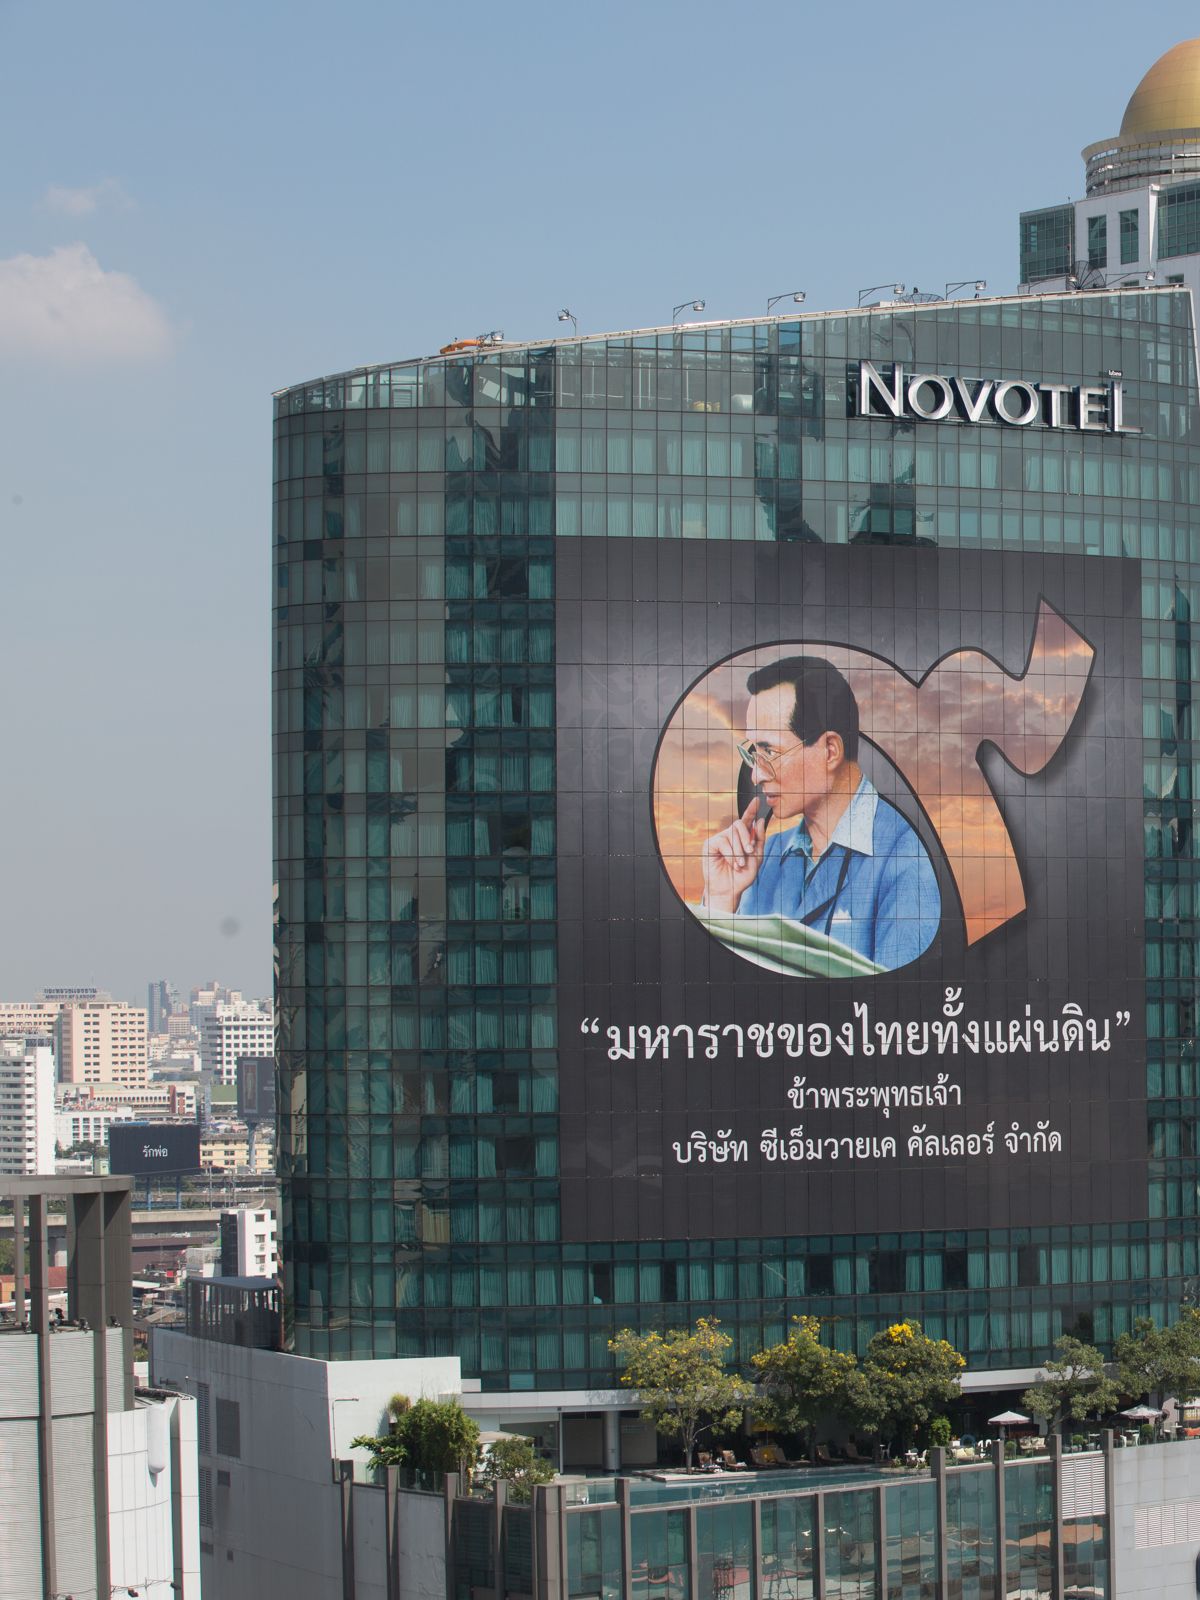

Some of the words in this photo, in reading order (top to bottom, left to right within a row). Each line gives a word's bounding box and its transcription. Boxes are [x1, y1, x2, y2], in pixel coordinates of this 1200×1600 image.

[858, 358, 1144, 434] NOVOTEL
[786, 1072, 962, 1119] ข้าพระพุทธเจ้า
[672, 1128, 748, 1163] บริษัท
[760, 1125, 897, 1161] ซีเอ็มวายเค
[907, 1121, 995, 1157] คัลเลอร์
[1004, 1120, 1062, 1154] จำกัด
